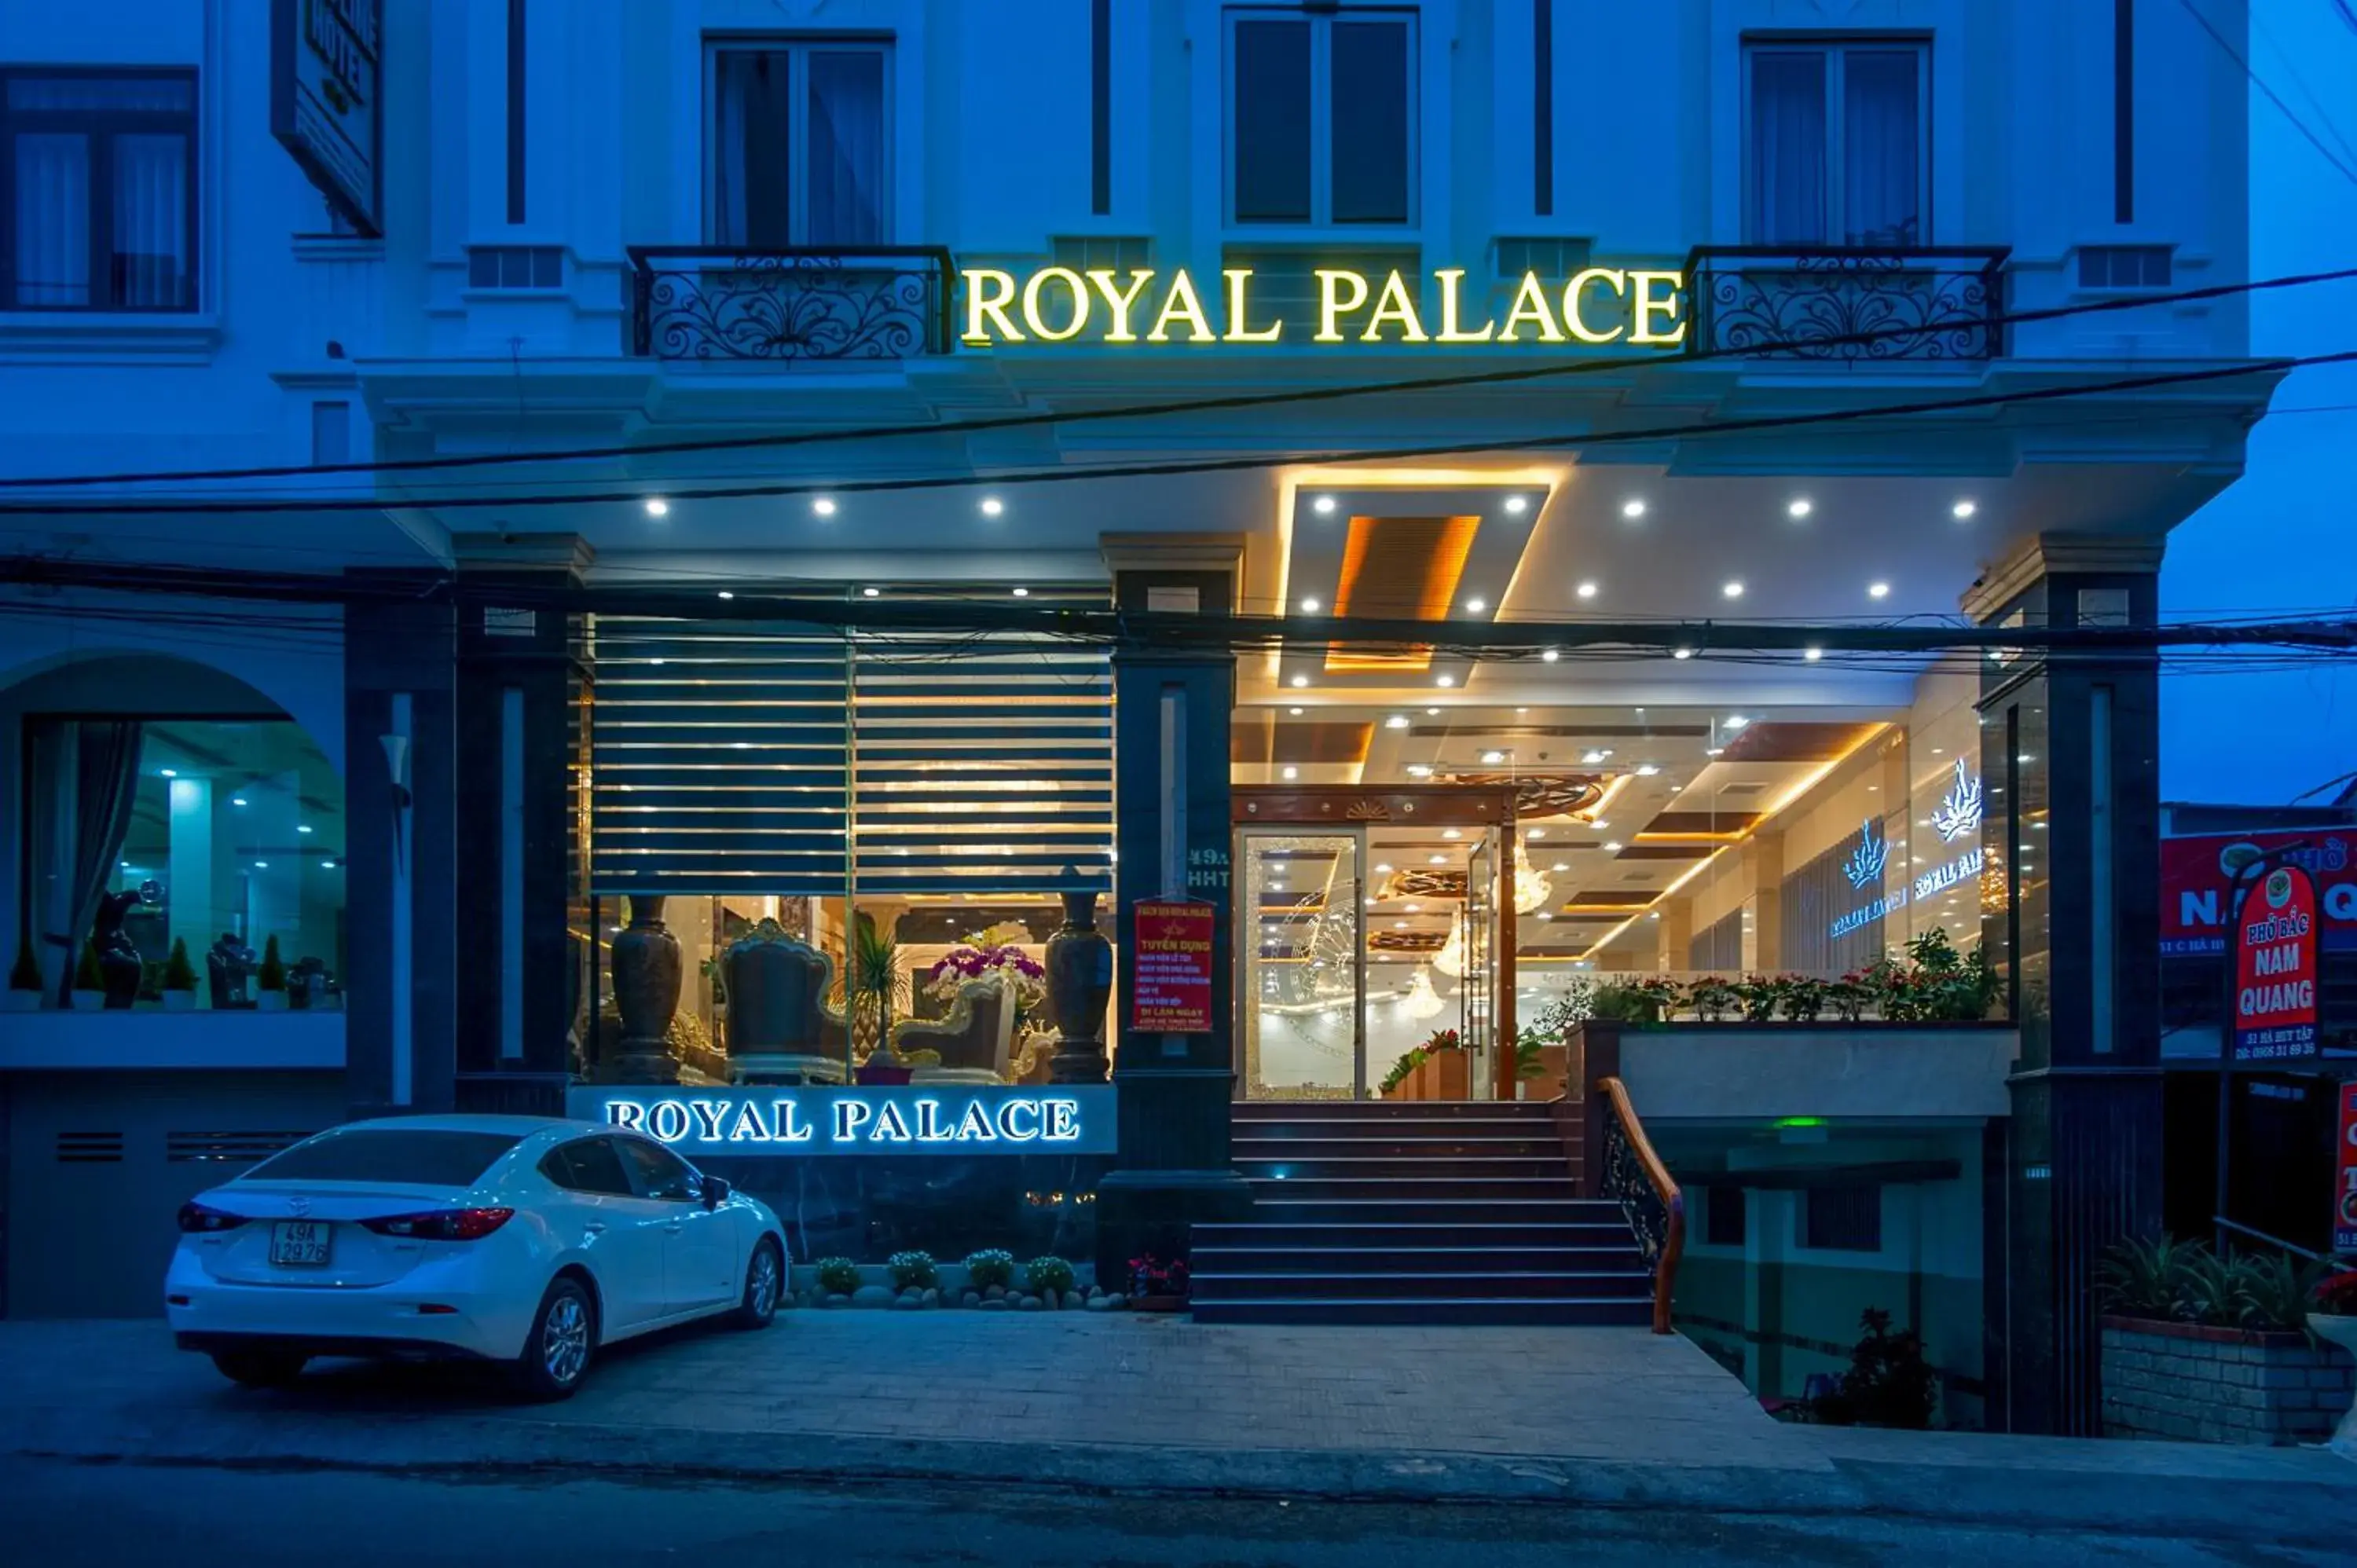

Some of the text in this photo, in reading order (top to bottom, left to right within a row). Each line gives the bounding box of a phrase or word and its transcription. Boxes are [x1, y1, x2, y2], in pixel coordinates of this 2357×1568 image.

[961, 269, 1687, 344] ROYAL PALACE
[1187, 870, 1230, 887] HHT
[2247, 911, 2278, 945] PHỞ
[2278, 904, 2310, 938] BẮC
[2255, 943, 2300, 976] NAM
[2239, 980, 2314, 1016] QUANG
[607, 1098, 1080, 1141] ROYAL PALACE
[286, 1223, 316, 1242] 49A
